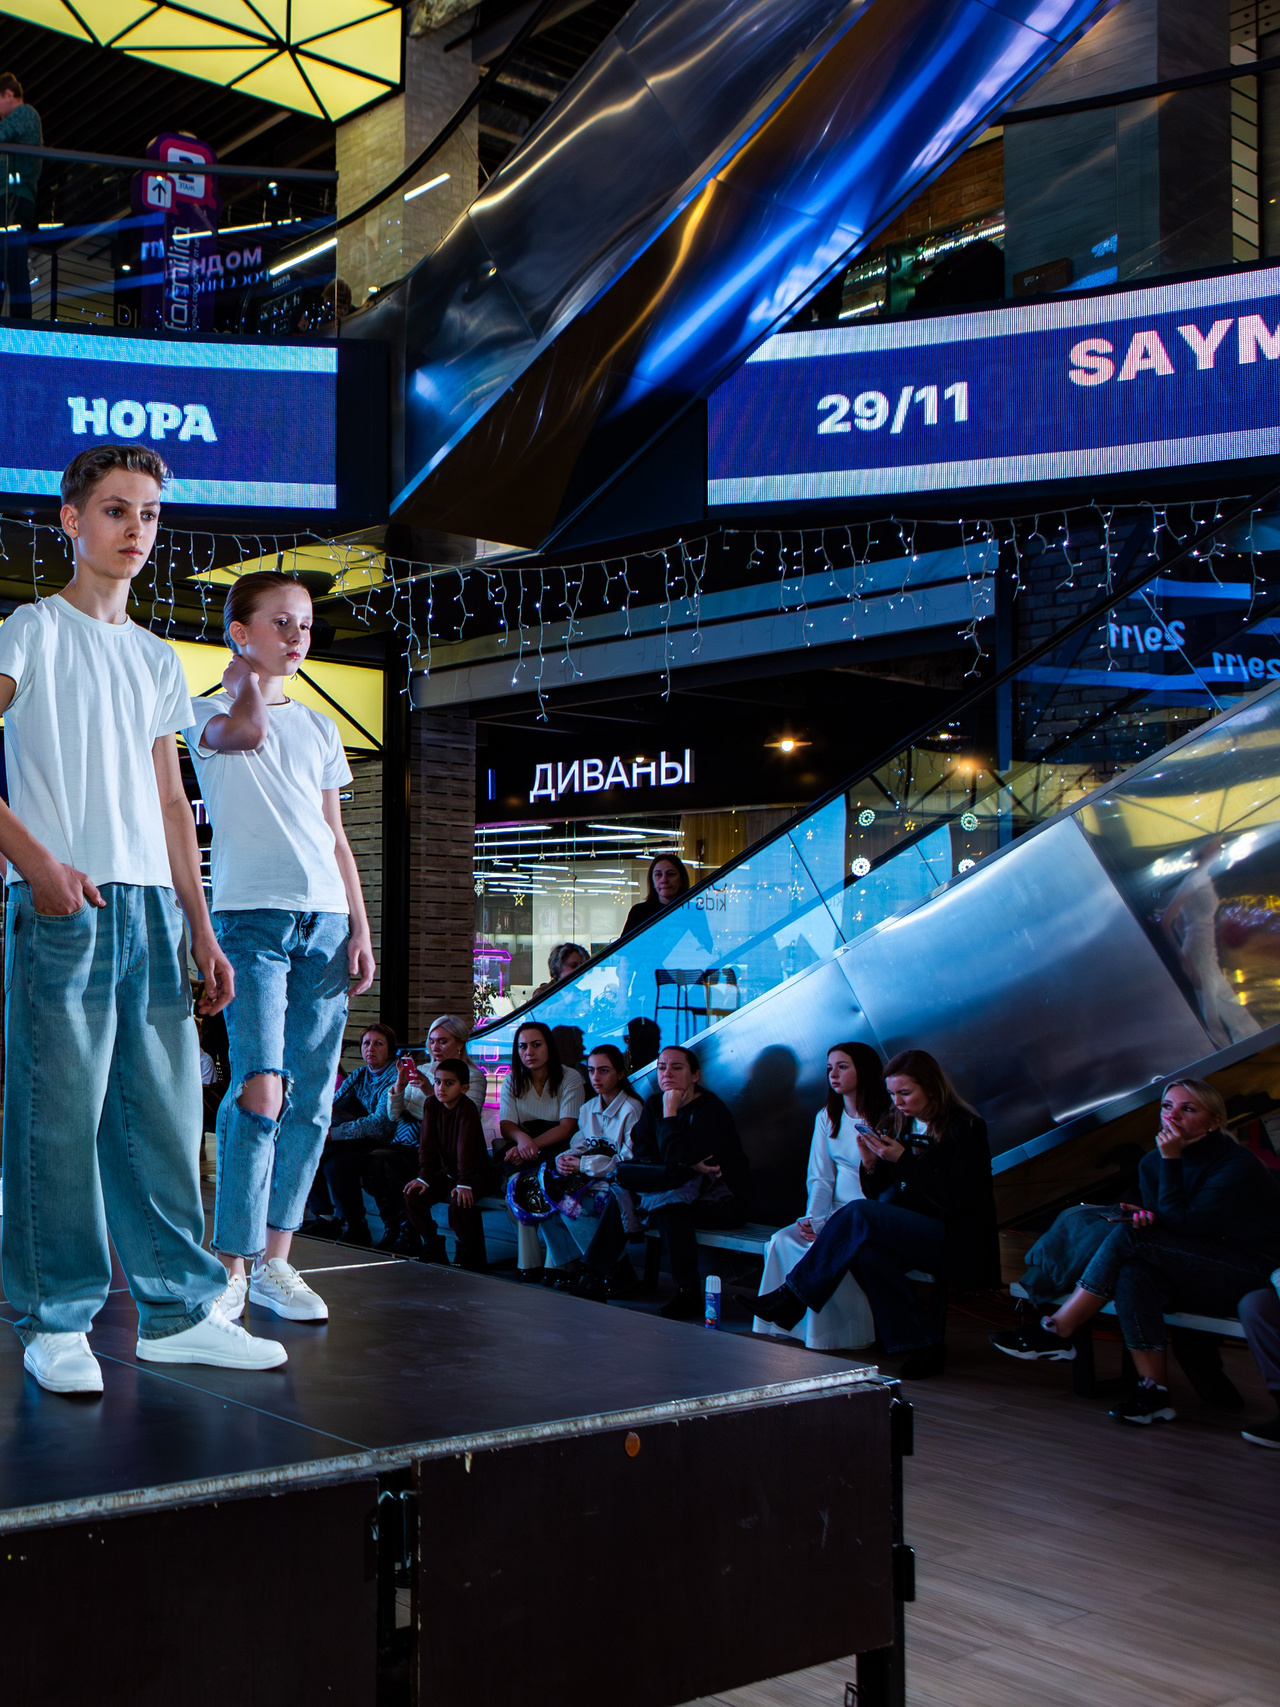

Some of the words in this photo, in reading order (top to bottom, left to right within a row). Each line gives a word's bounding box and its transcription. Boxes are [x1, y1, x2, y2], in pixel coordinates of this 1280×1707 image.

[164, 225, 191, 332] familia
[67, 396, 218, 443] НОРА
[816, 382, 969, 435] 29/11
